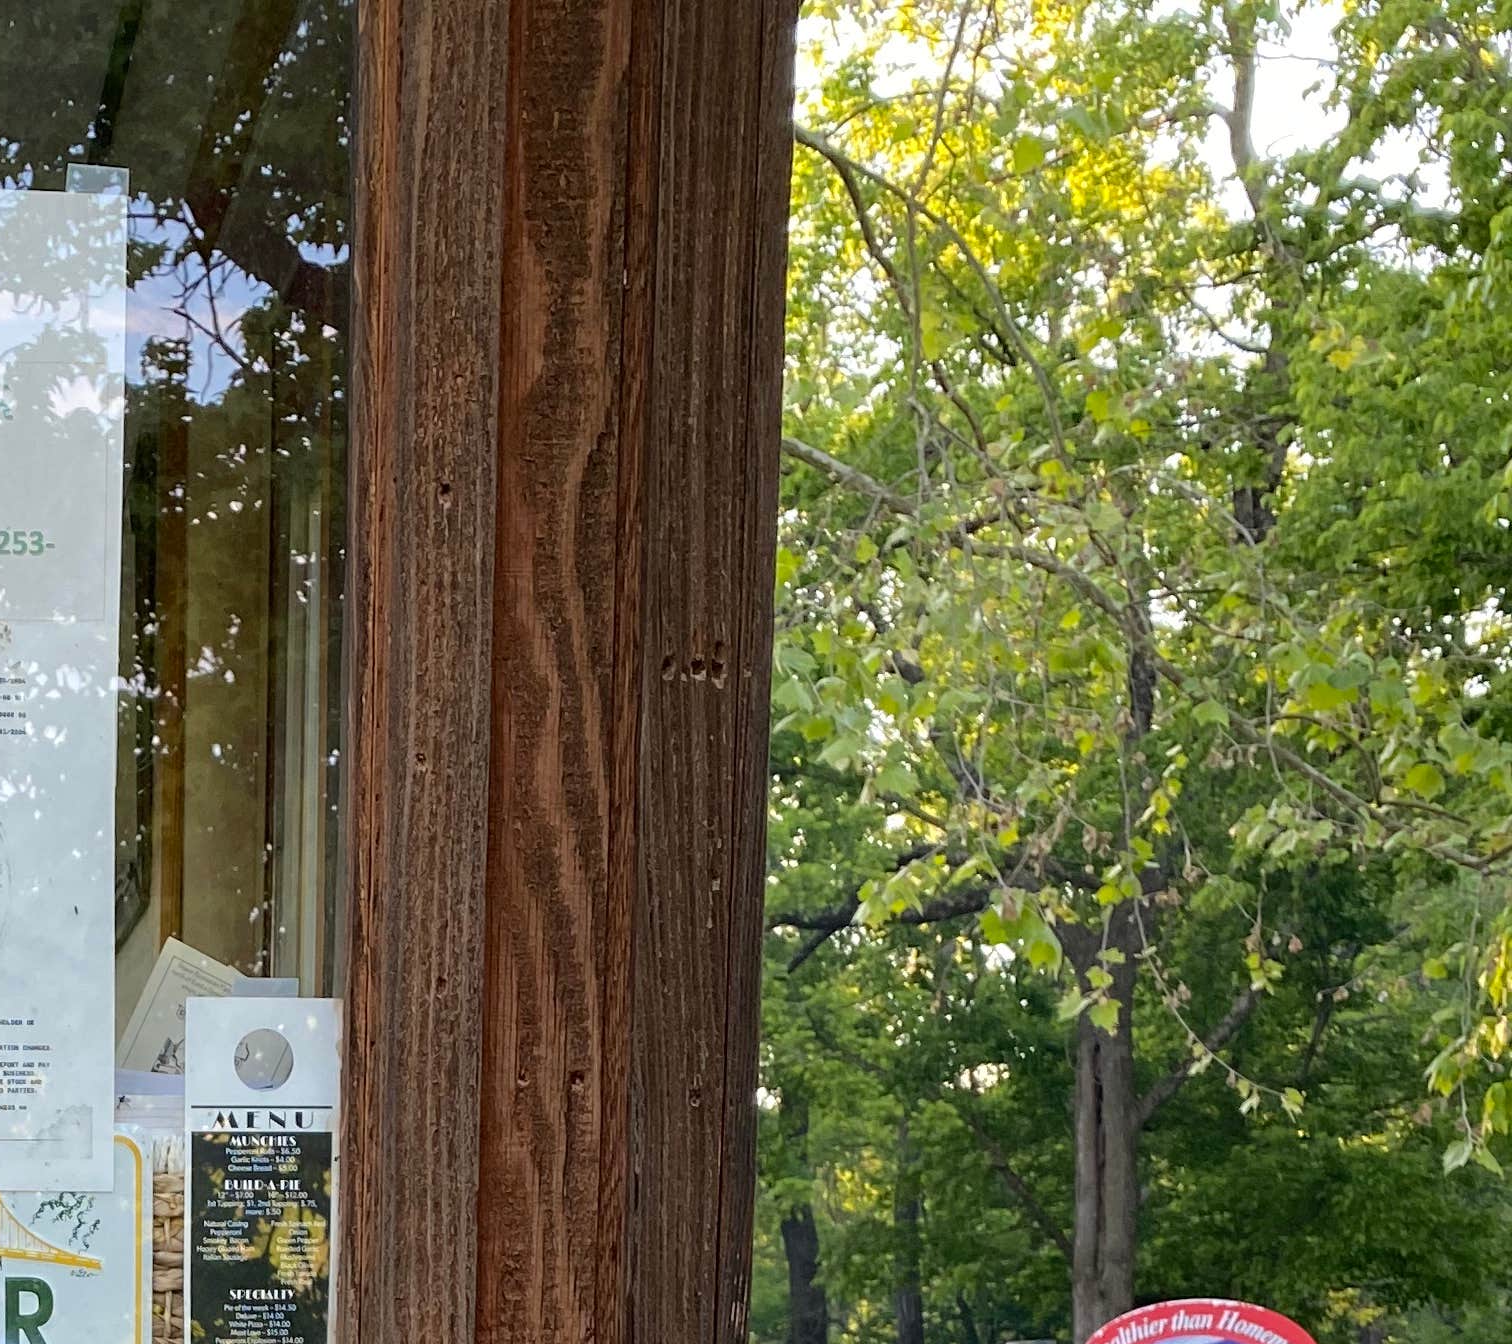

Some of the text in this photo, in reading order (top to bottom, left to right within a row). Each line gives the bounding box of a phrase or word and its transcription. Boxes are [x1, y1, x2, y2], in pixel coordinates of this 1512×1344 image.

[212, 1111, 314, 1128] MENU
[230, 1136, 296, 1146] MUNCHIES
[224, 1180, 300, 1190] BUILD-A-PIE
[230, 1289, 295, 1300] SPECIALTY
[1171, 1309, 1214, 1331] than
